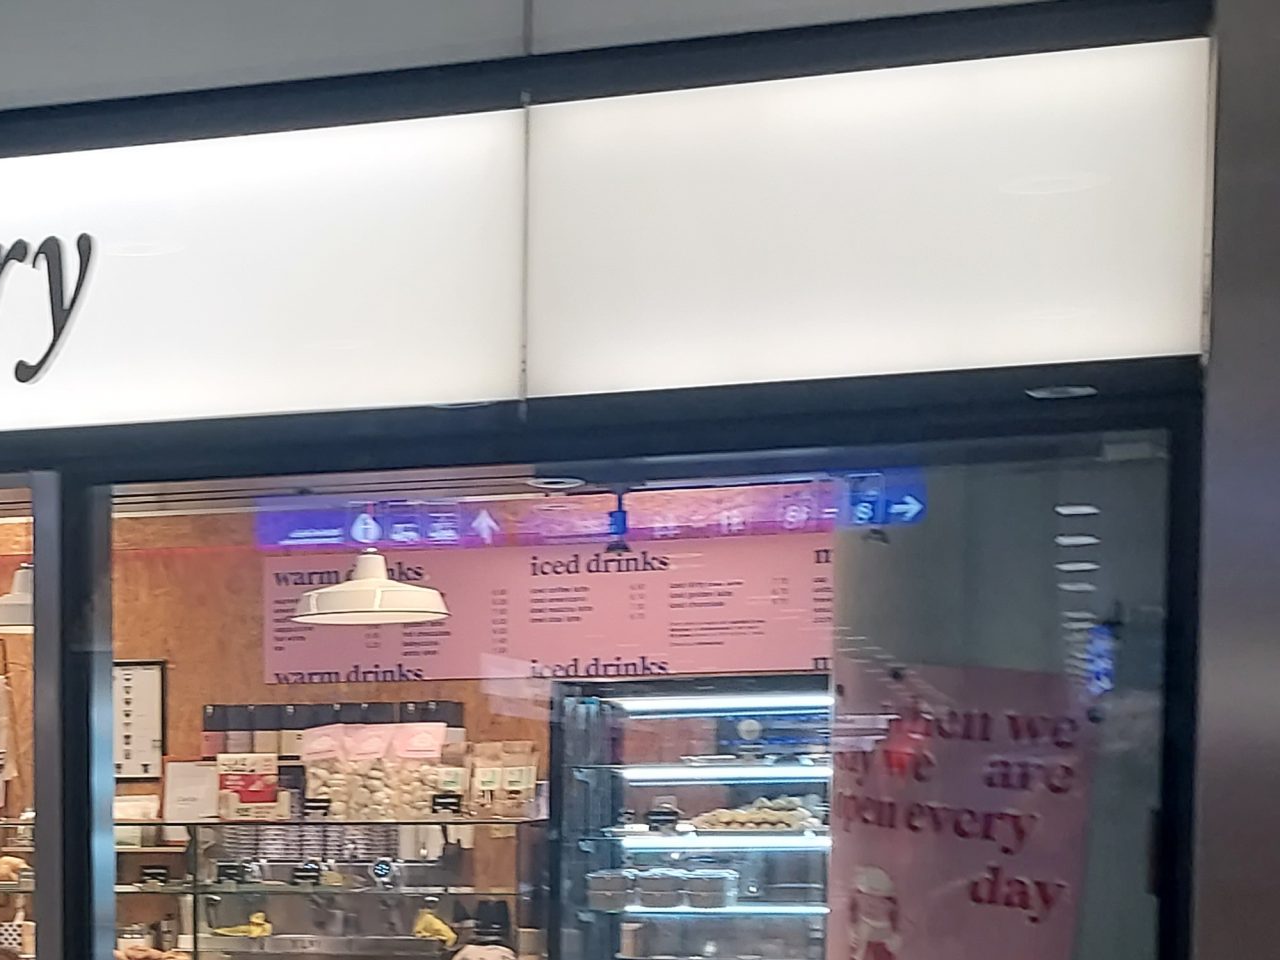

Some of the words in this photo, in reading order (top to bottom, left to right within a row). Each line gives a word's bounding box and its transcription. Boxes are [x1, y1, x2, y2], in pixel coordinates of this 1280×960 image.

[272, 567, 340, 587] warm
[530, 555, 580, 577] iced
[587, 551, 670, 575] drinks
[273, 670, 340, 684] warm
[346, 663, 424, 684] drinks
[530, 657, 580, 678] iced
[586, 656, 670, 676] drinks
[1004, 714, 1080, 749] we
[983, 758, 1076, 795] are
[905, 801, 1042, 856] every
[969, 864, 1069, 925] day
